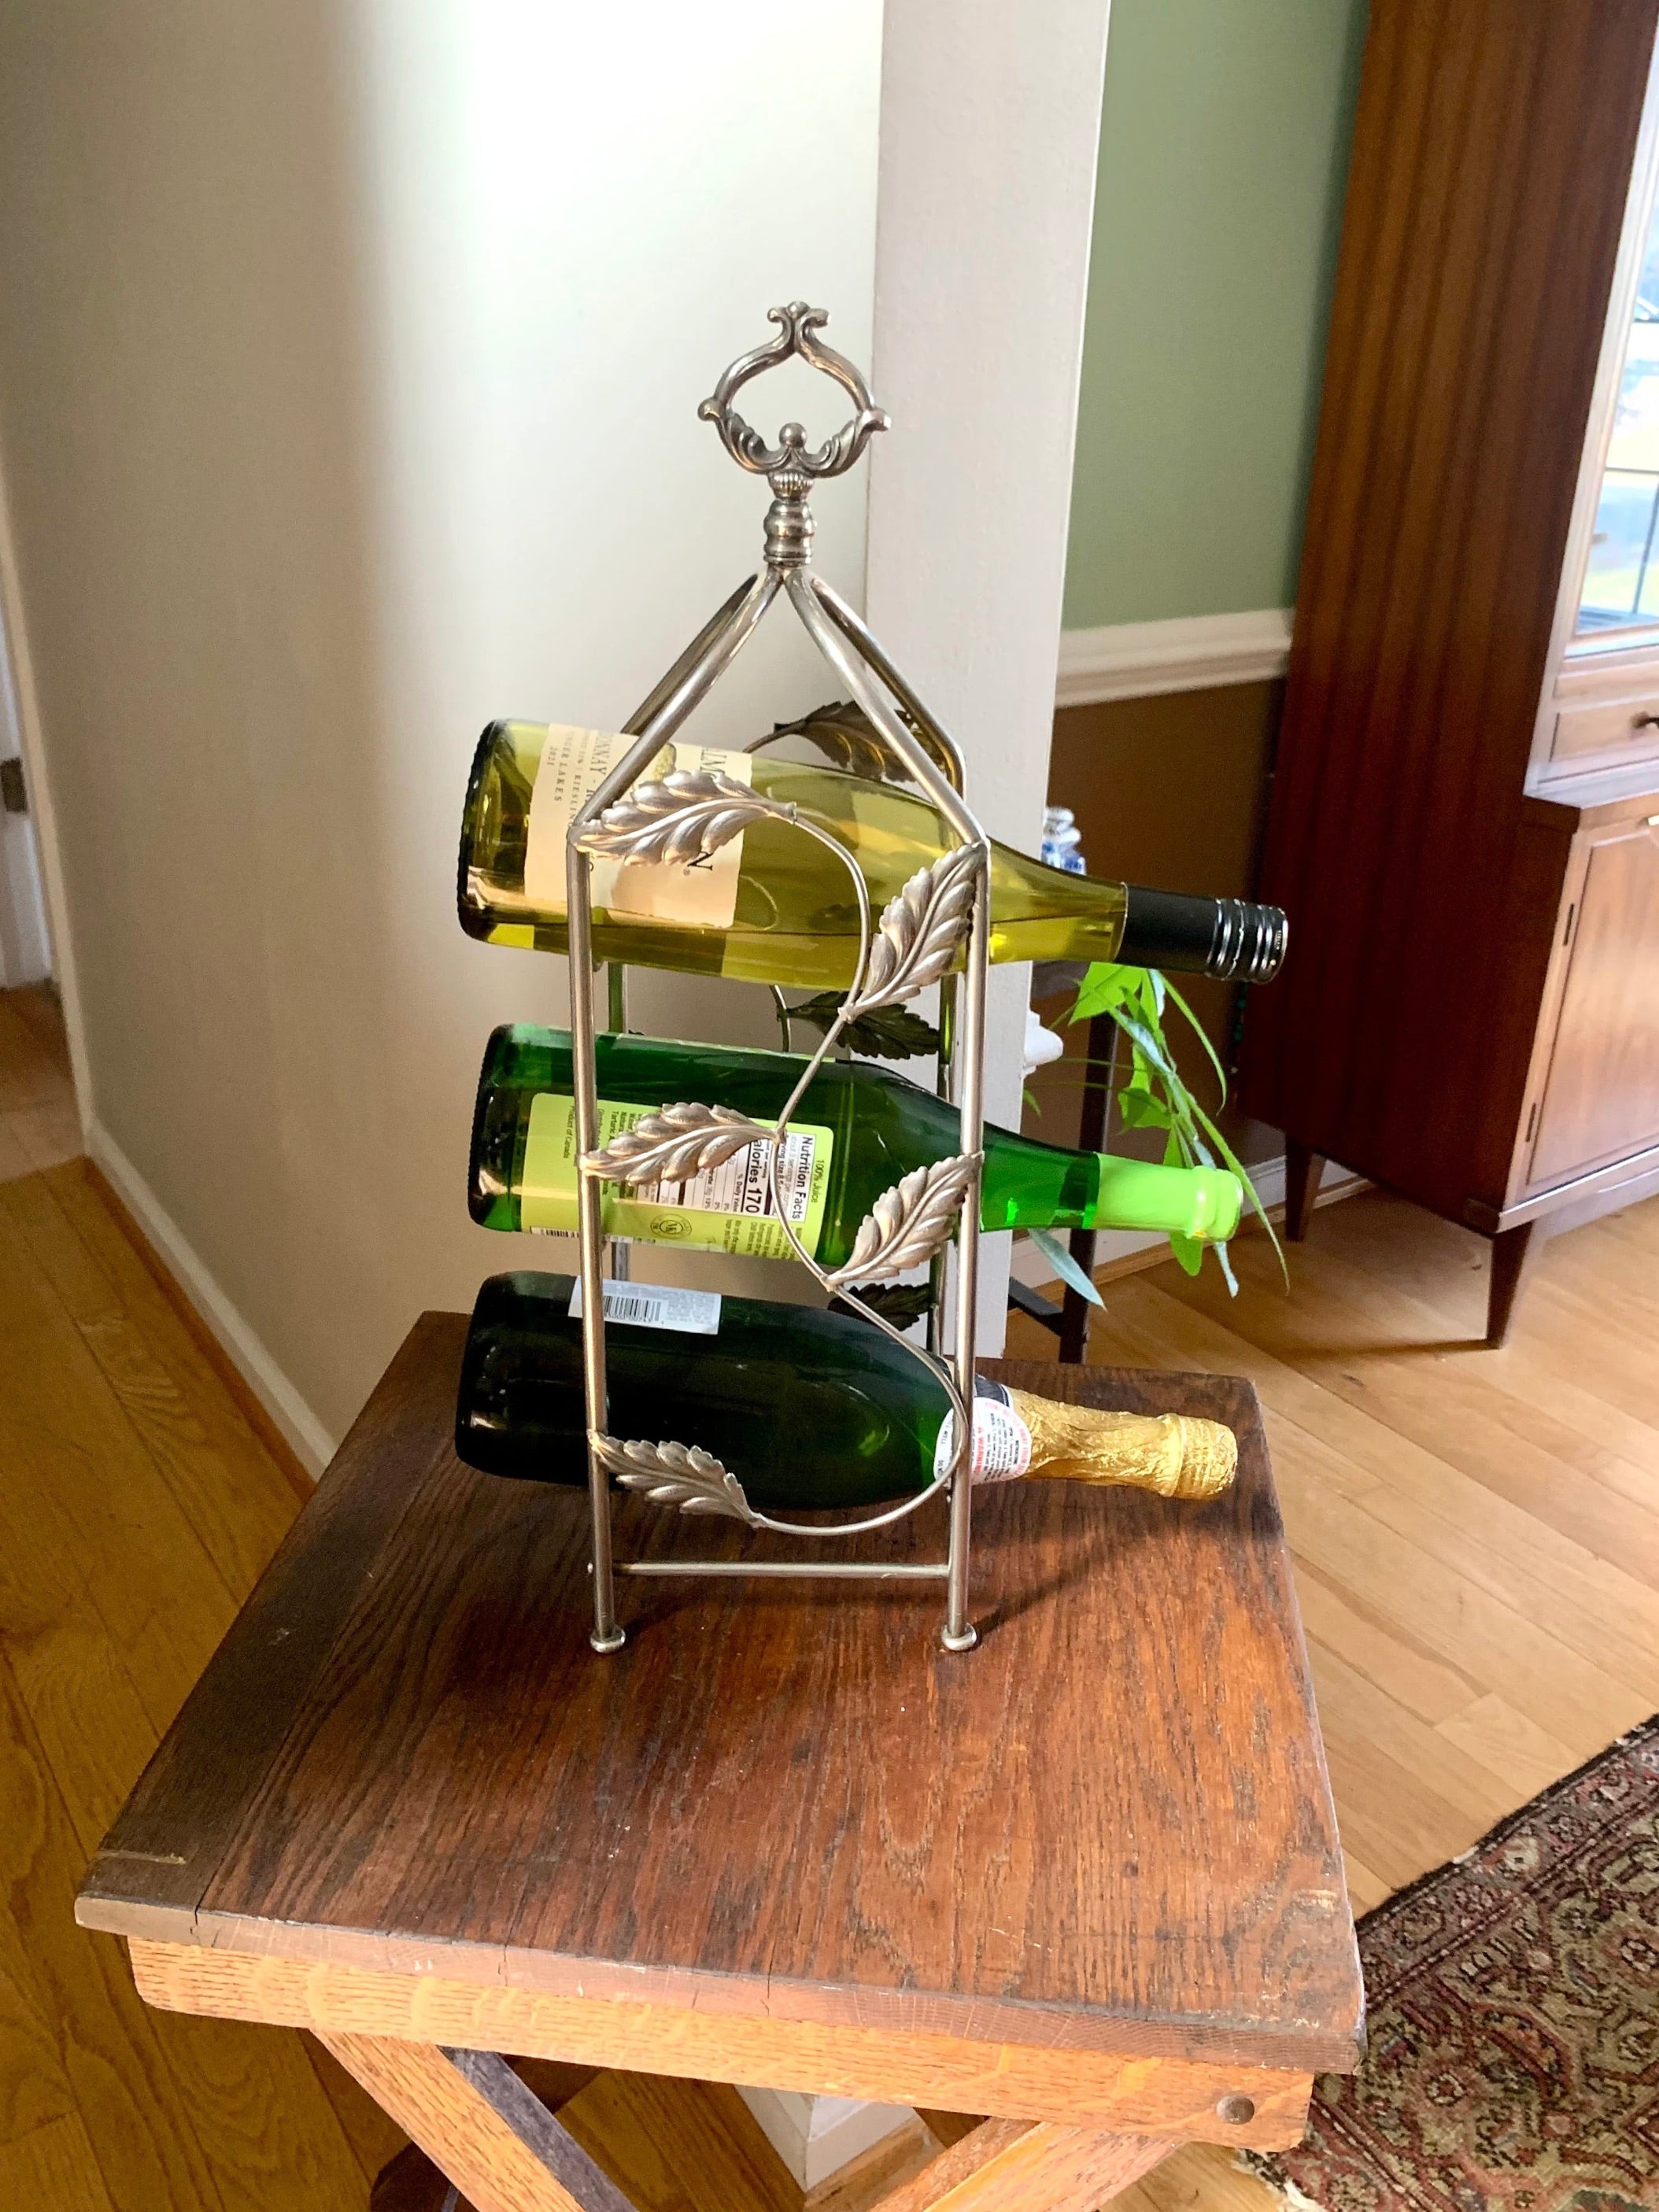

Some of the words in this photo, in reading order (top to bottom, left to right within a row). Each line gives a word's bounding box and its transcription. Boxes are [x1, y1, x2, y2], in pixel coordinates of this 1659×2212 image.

[619, 1111, 627, 1132] Natura
[563, 1136, 572, 1159] Canada
[748, 1140, 764, 1184] alories
[796, 1136, 814, 1187] Nutrition
[813, 1160, 825, 1181] 100%
[733, 1181, 742, 1195] Daily
[811, 1183, 820, 1203] Juice
[732, 1198, 741, 1212] Value
[745, 1187, 763, 1213] 170
[792, 1192, 807, 1220] Facts
